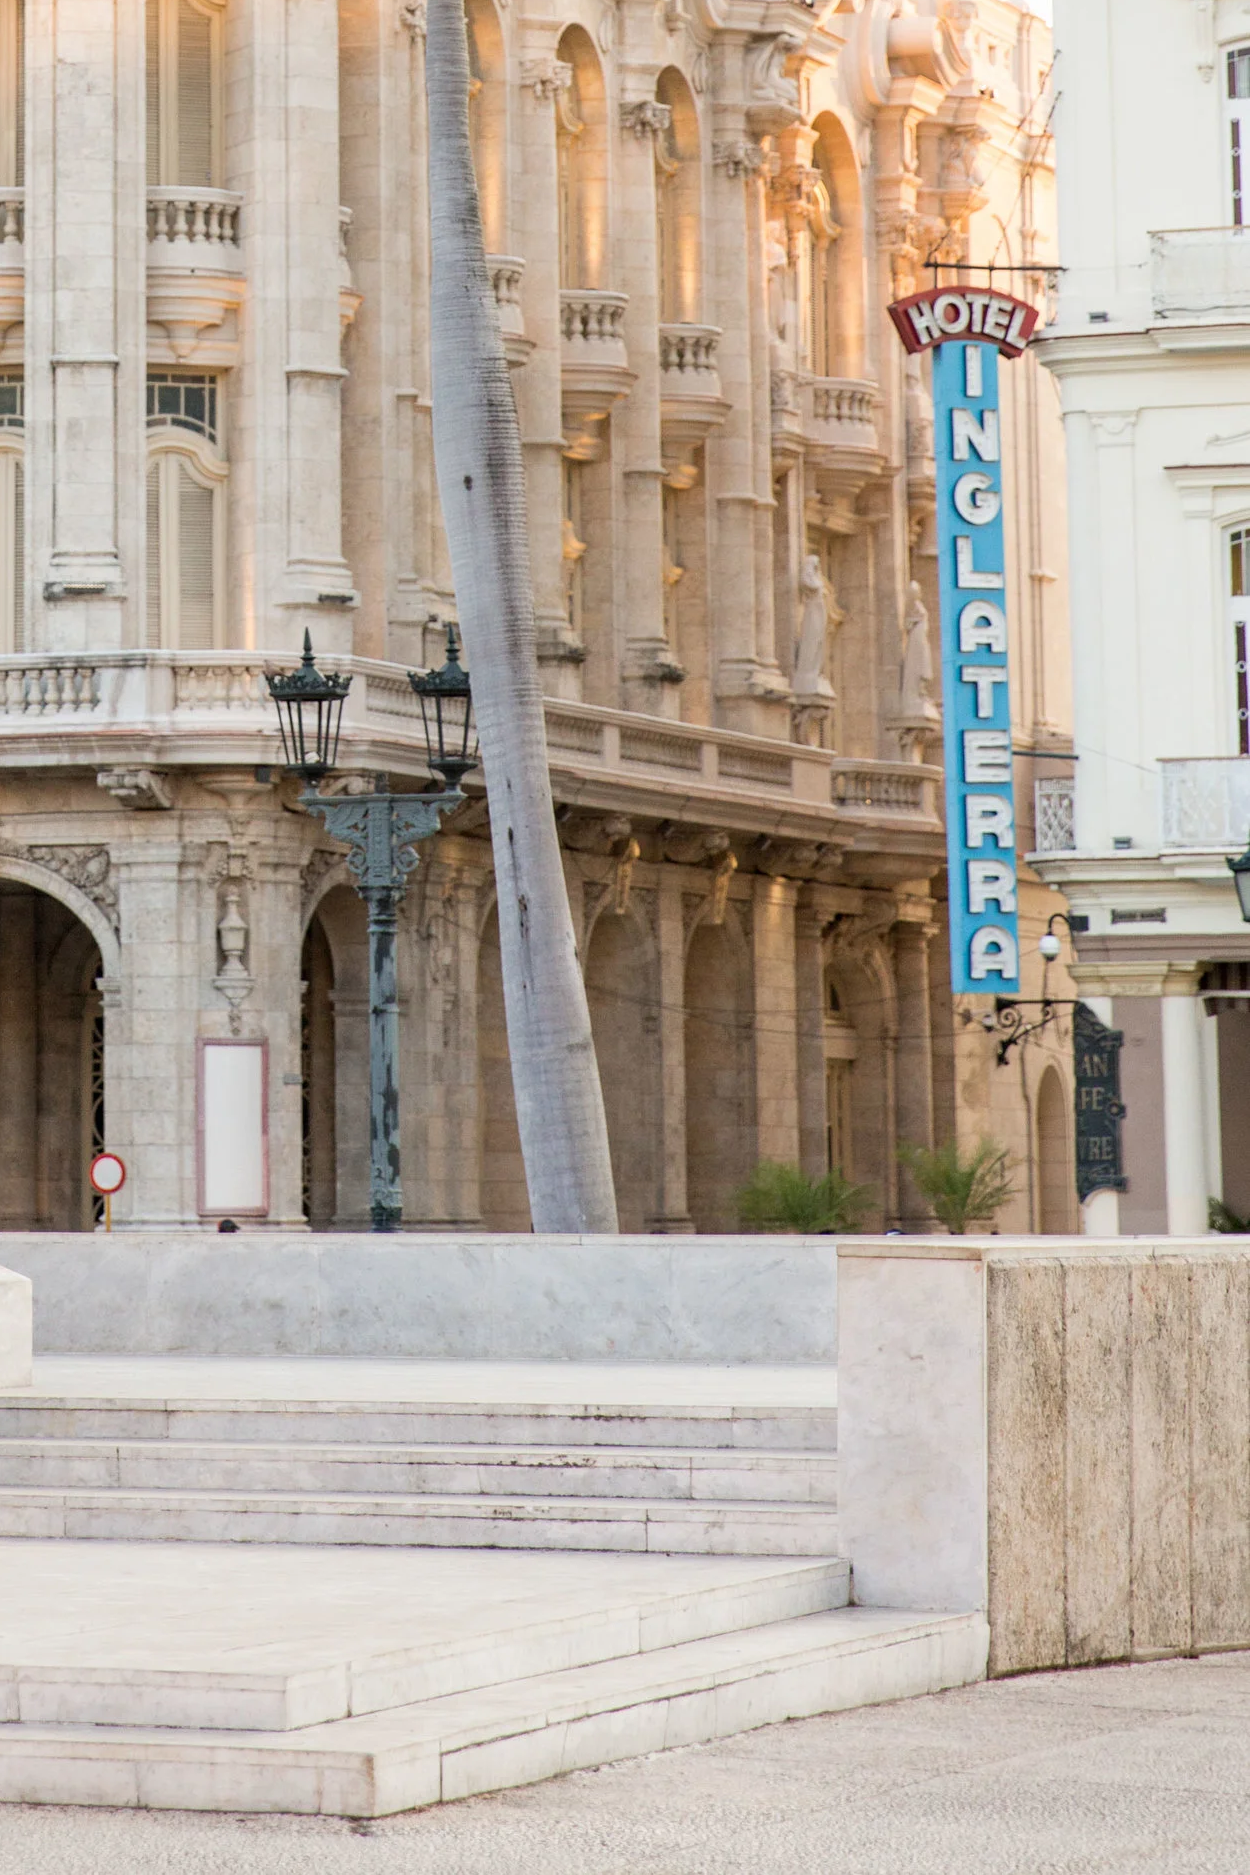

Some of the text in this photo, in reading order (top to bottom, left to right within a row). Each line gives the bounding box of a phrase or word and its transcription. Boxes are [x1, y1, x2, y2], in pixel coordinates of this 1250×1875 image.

[907, 292, 1028, 350] HOTEL
[951, 344, 1018, 982] INGLATERRA
[1081, 1052, 1109, 1077] AN
[1080, 1086, 1106, 1111] FE
[1077, 1135, 1114, 1160] VRE
